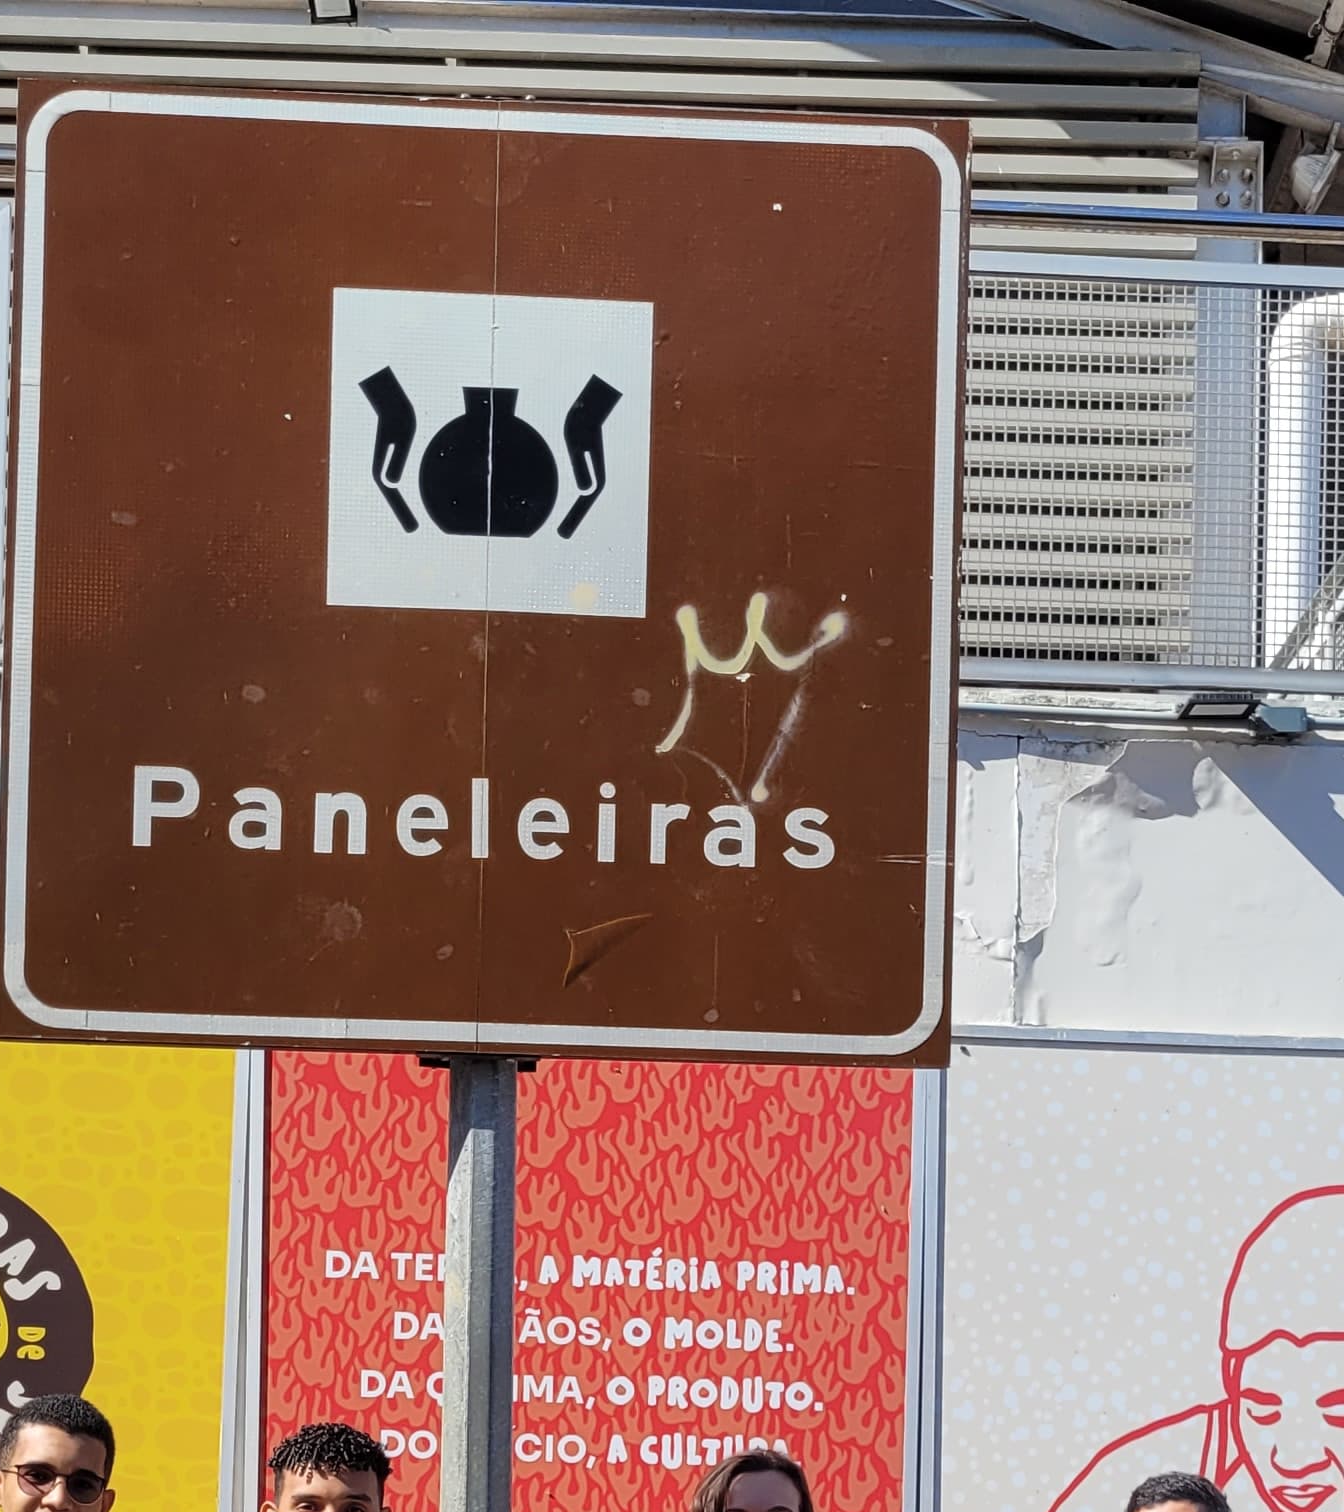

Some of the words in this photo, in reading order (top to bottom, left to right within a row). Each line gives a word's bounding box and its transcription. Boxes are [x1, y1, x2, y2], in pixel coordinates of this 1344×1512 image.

[131, 764, 836, 869] Paneleiras
[324, 1249, 380, 1280] DA
[538, 1254, 560, 1286] A
[518, 1307, 613, 1352] ÃOS,
[622, 1316, 652, 1348] O
[663, 1316, 795, 1353] MOLDE.
[359, 1369, 415, 1400] DA
[606, 1375, 636, 1406] O
[646, 1374, 824, 1414] PRODUTO.
[606, 1433, 628, 1465] A
